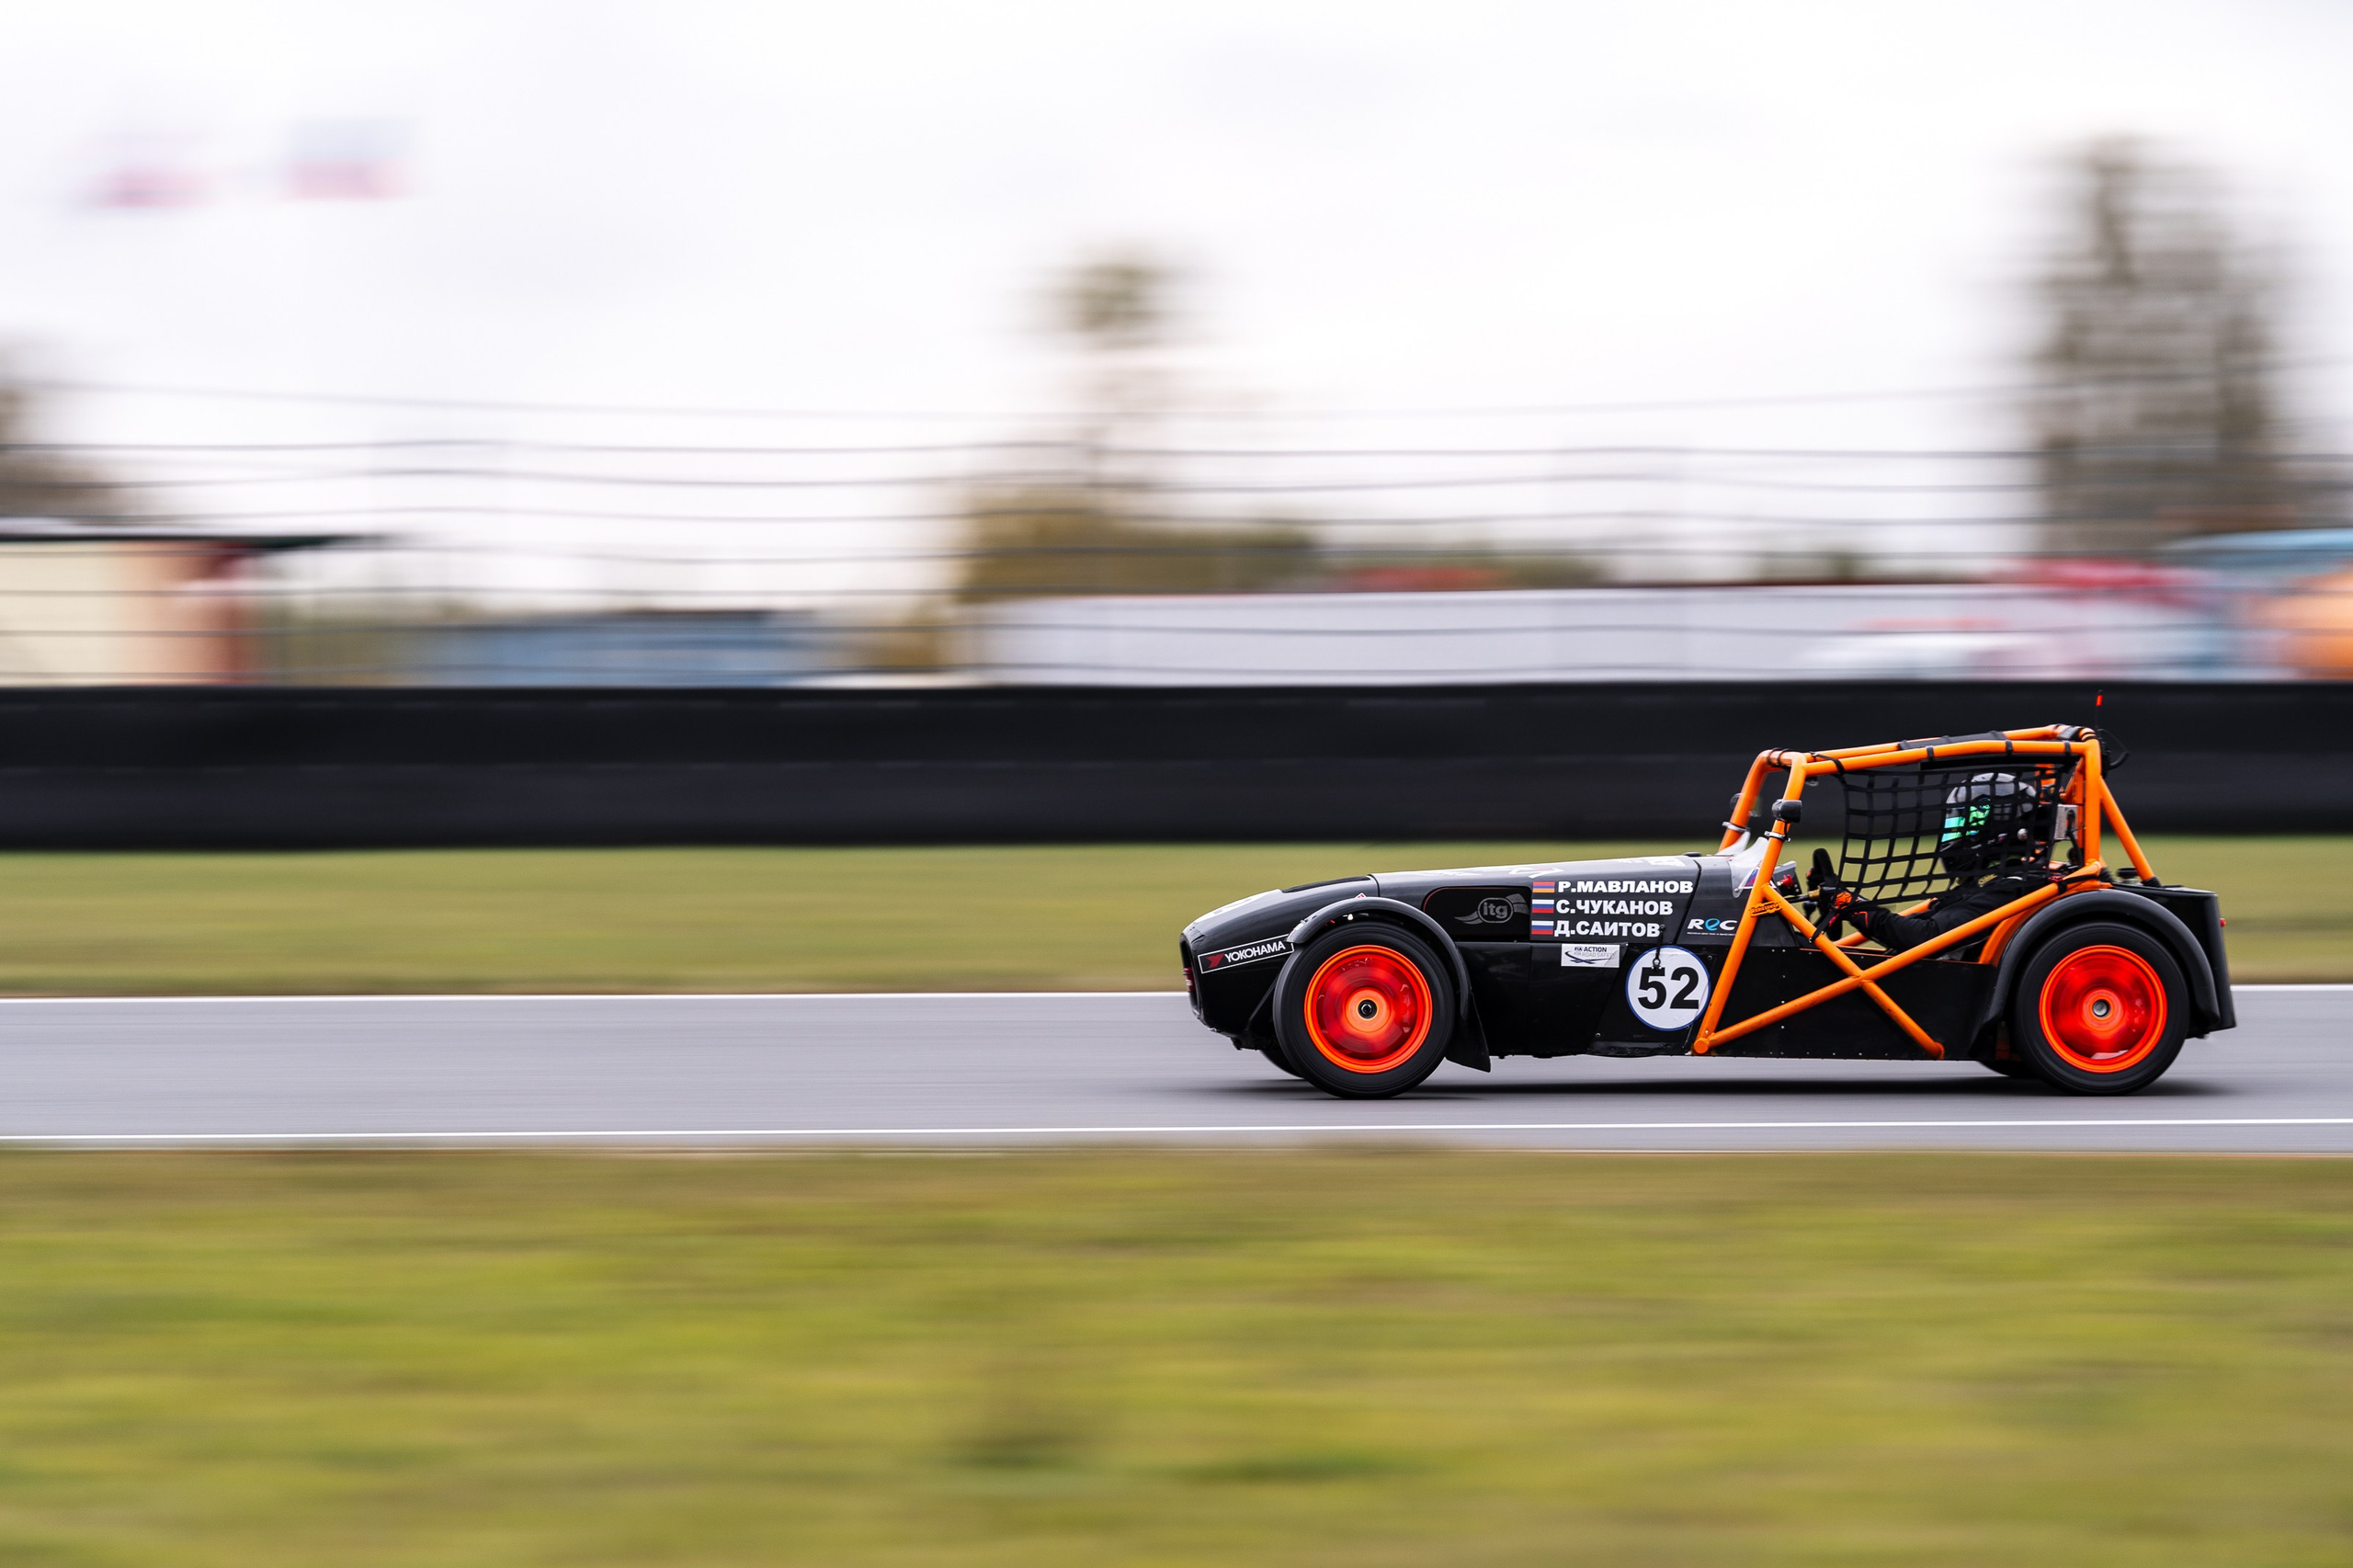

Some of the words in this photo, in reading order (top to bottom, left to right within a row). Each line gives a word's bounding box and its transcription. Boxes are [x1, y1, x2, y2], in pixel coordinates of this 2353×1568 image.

[1558, 881, 1694, 893] Р.МАВЛАНОВ
[1483, 901, 1508, 919] itg
[1555, 899, 1673, 915] С.ЧУКАНОВ
[1553, 920, 1661, 937] Д.САИТОВ
[1224, 940, 1286, 963] YOKOHAMA
[1637, 966, 1699, 1010] 52
